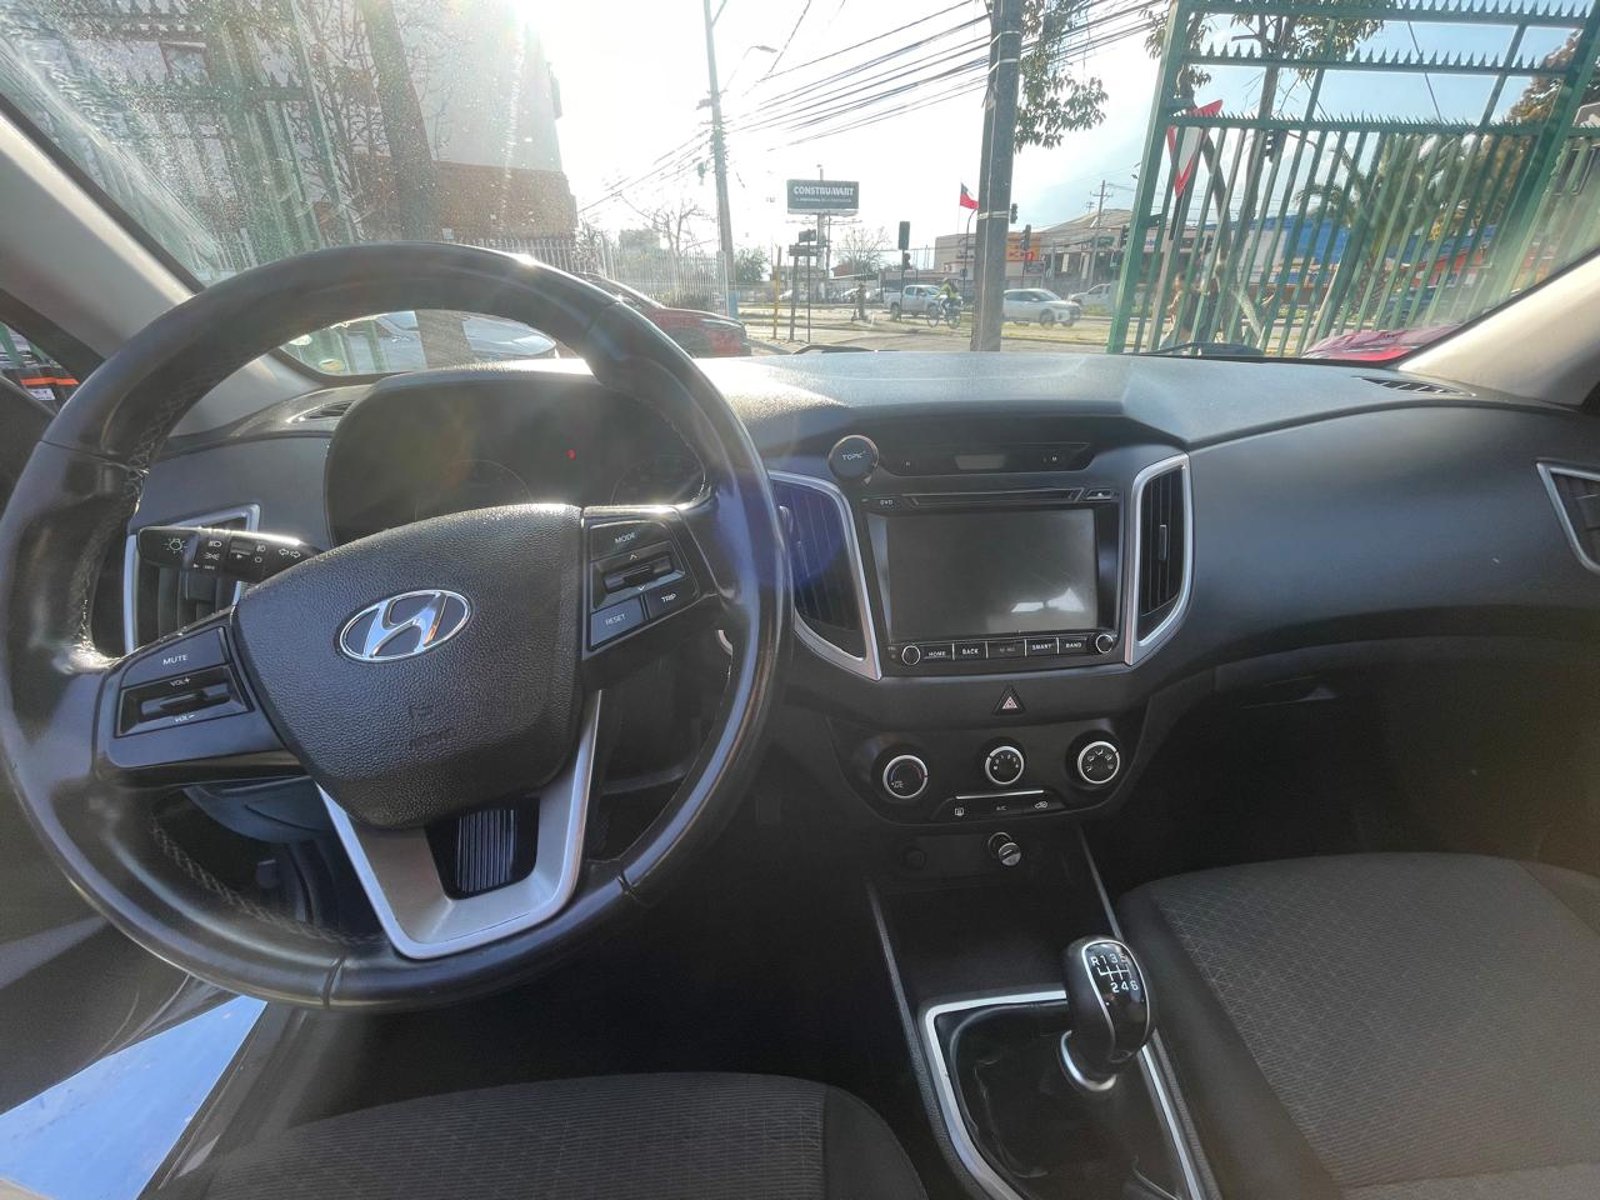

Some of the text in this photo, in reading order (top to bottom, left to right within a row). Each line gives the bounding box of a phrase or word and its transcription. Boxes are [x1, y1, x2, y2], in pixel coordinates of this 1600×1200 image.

[793, 186, 854, 196] CONSTRUMART
[615, 532, 636, 543] MODE
[661, 593, 677, 602] TRIP
[605, 614, 626, 625] RESET
[163, 654, 188, 665] MUTE
[1090, 956, 1101, 966] R
[1100, 955, 1107, 964] 1
[1109, 953, 1118, 963] 3
[1110, 980, 1139, 993] 2 4 6
